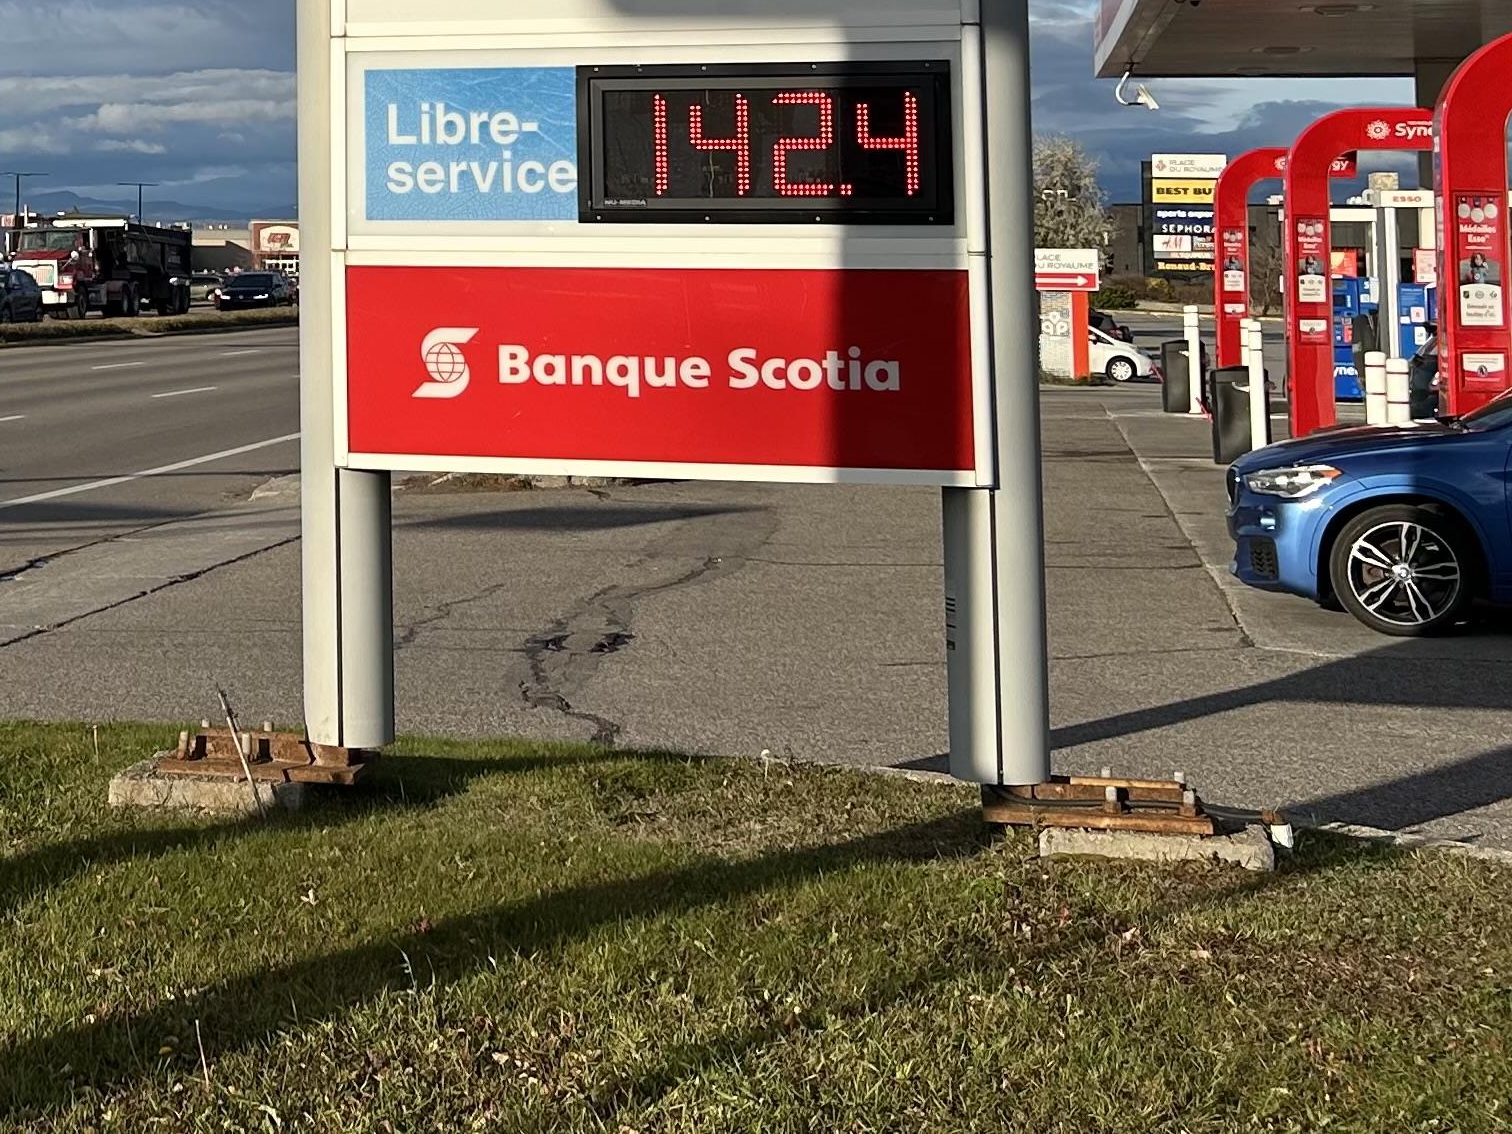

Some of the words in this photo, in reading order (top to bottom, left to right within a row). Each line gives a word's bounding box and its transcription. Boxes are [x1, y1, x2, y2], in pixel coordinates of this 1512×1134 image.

[387, 103, 540, 145] Libre-
[653, 90, 921, 198] 142.4
[386, 148, 578, 194] service
[1156, 187, 1190, 195] BEST
[1192, 187, 1216, 195] BU
[498, 344, 712, 398] Banque
[727, 346, 901, 393] Scotia
